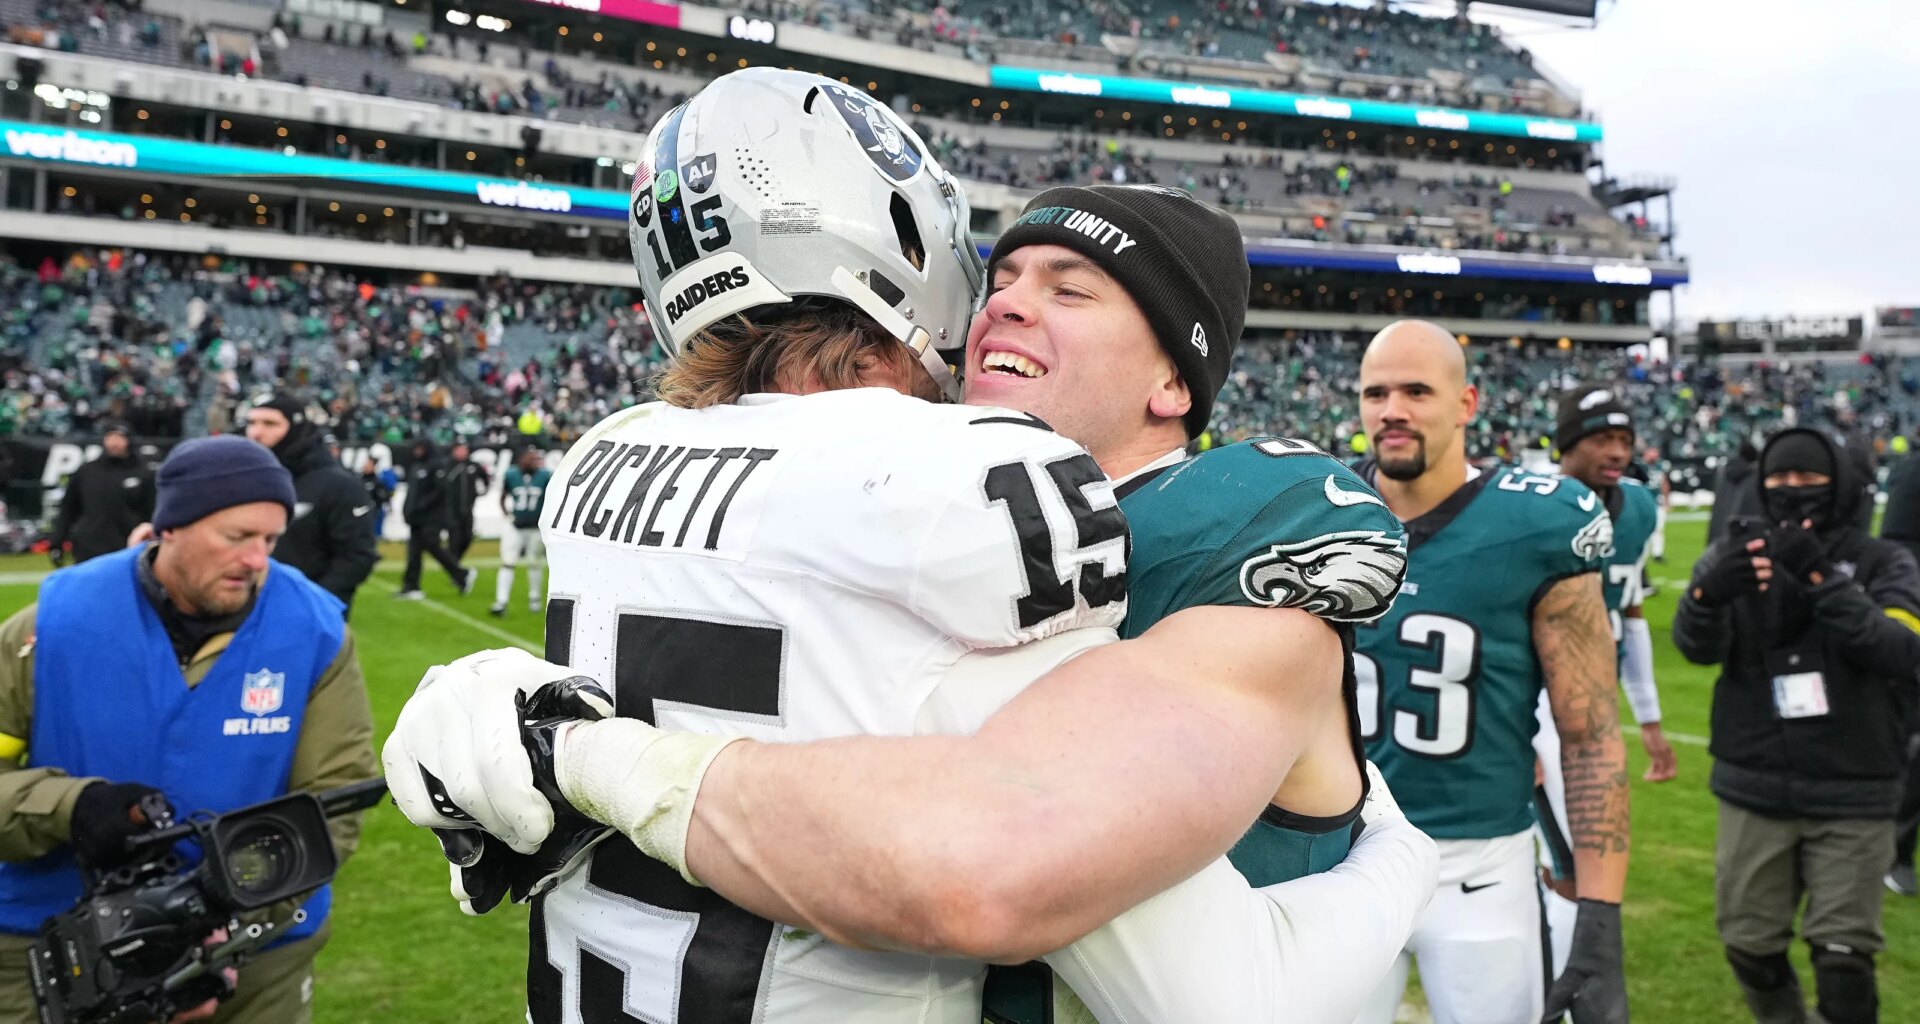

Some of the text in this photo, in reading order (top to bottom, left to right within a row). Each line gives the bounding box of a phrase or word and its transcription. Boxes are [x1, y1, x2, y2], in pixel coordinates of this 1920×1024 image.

[5, 129, 137, 168] verizon
[688, 161, 714, 183] AL
[476, 180, 572, 212] verizon
[636, 194, 651, 217] CD
[665, 265, 750, 325] RAIDERS
[551, 440, 779, 551] PICKETT
[983, 452, 1132, 629] 15
[223, 716, 291, 735] NFL FILMS
